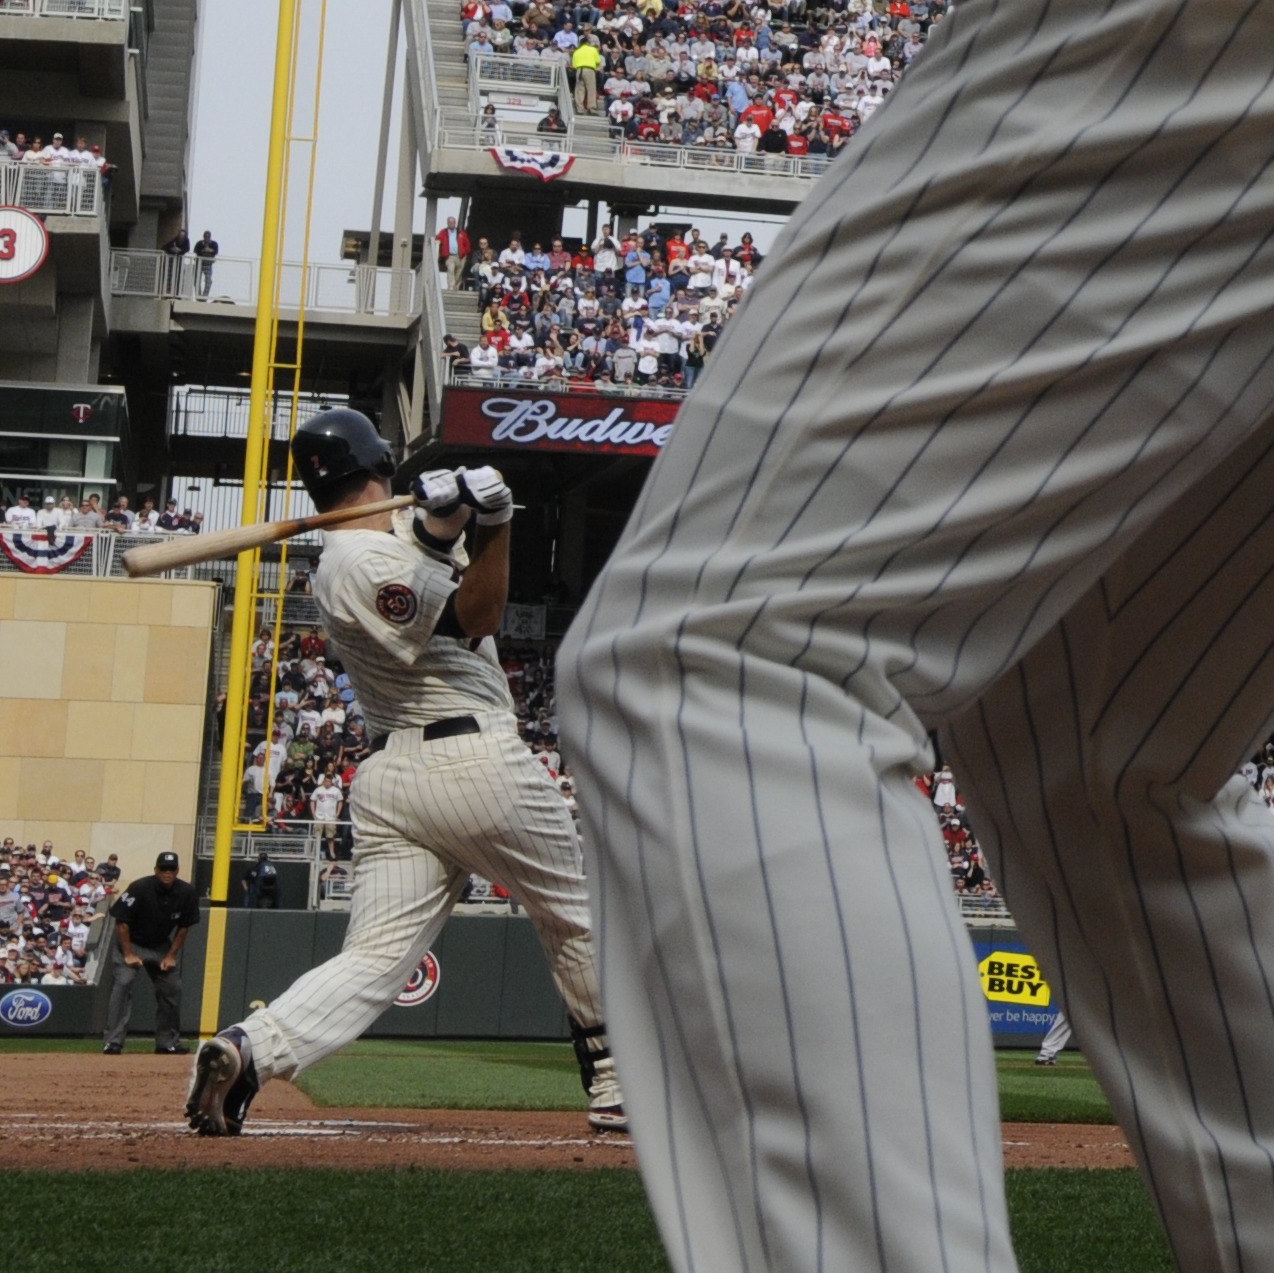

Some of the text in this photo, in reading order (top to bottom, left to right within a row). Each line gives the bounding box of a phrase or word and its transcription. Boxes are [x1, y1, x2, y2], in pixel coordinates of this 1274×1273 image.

[121, 891, 136, 907] 44
[988, 961, 1040, 979] BES
[988, 978, 1044, 997] BUY
[7, 996, 42, 1022] Ford
[1006, 1010, 1020, 1021] be
